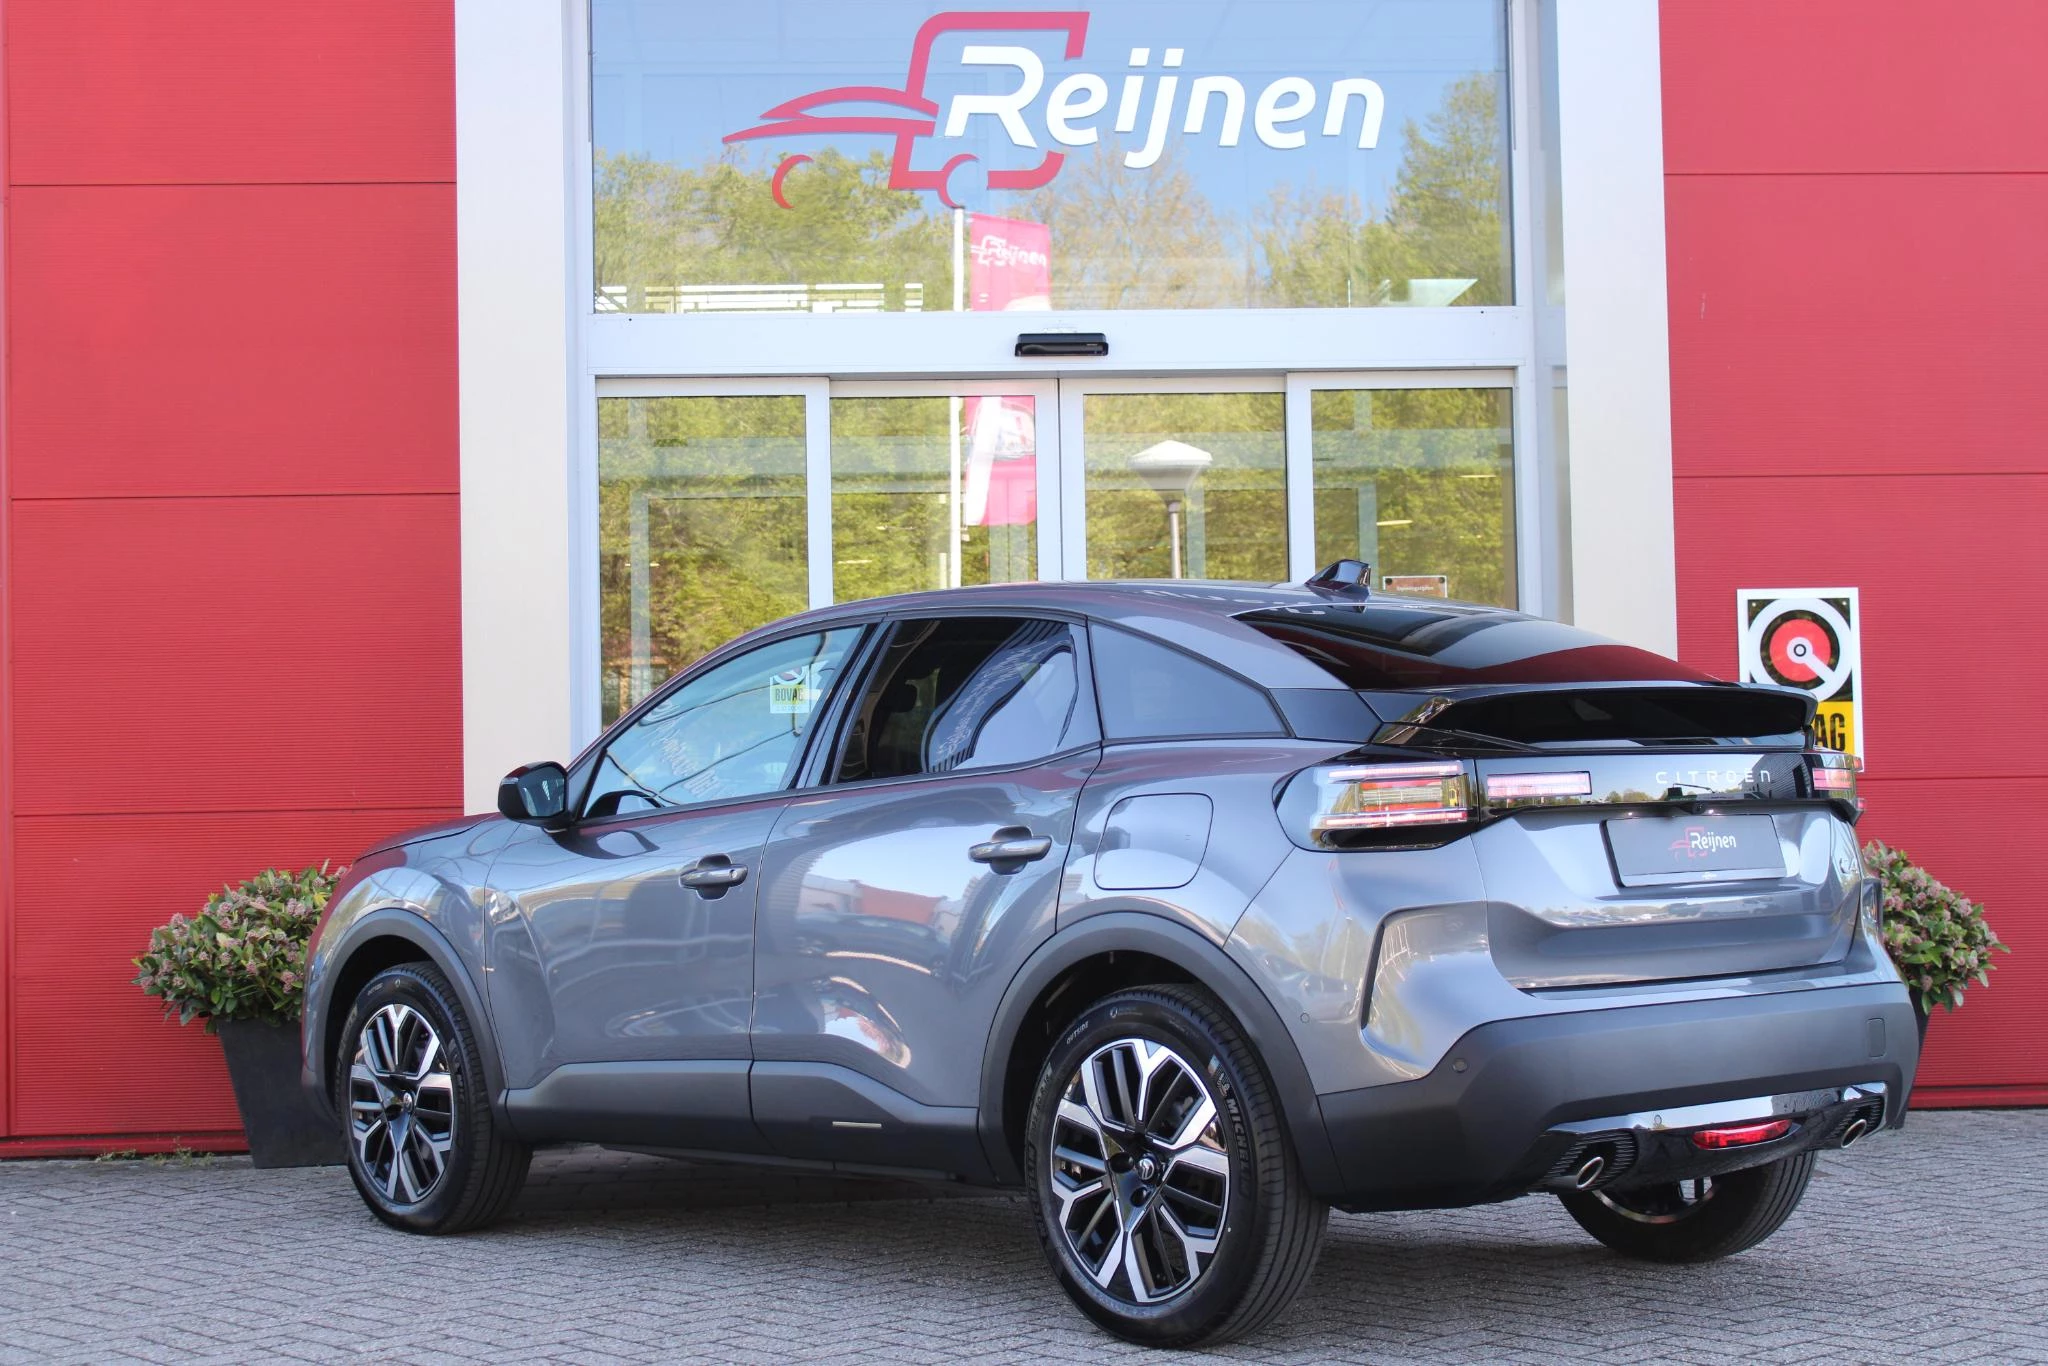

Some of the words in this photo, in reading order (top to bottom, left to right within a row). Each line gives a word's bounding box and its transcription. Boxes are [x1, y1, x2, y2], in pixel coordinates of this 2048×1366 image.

[944, 45, 1385, 169] Reijnen
[1690, 831, 1737, 852] Reijnen
[1066, 1020, 1089, 1045] OUTSIDE
[1226, 1098, 1249, 1197] MICHELIN
